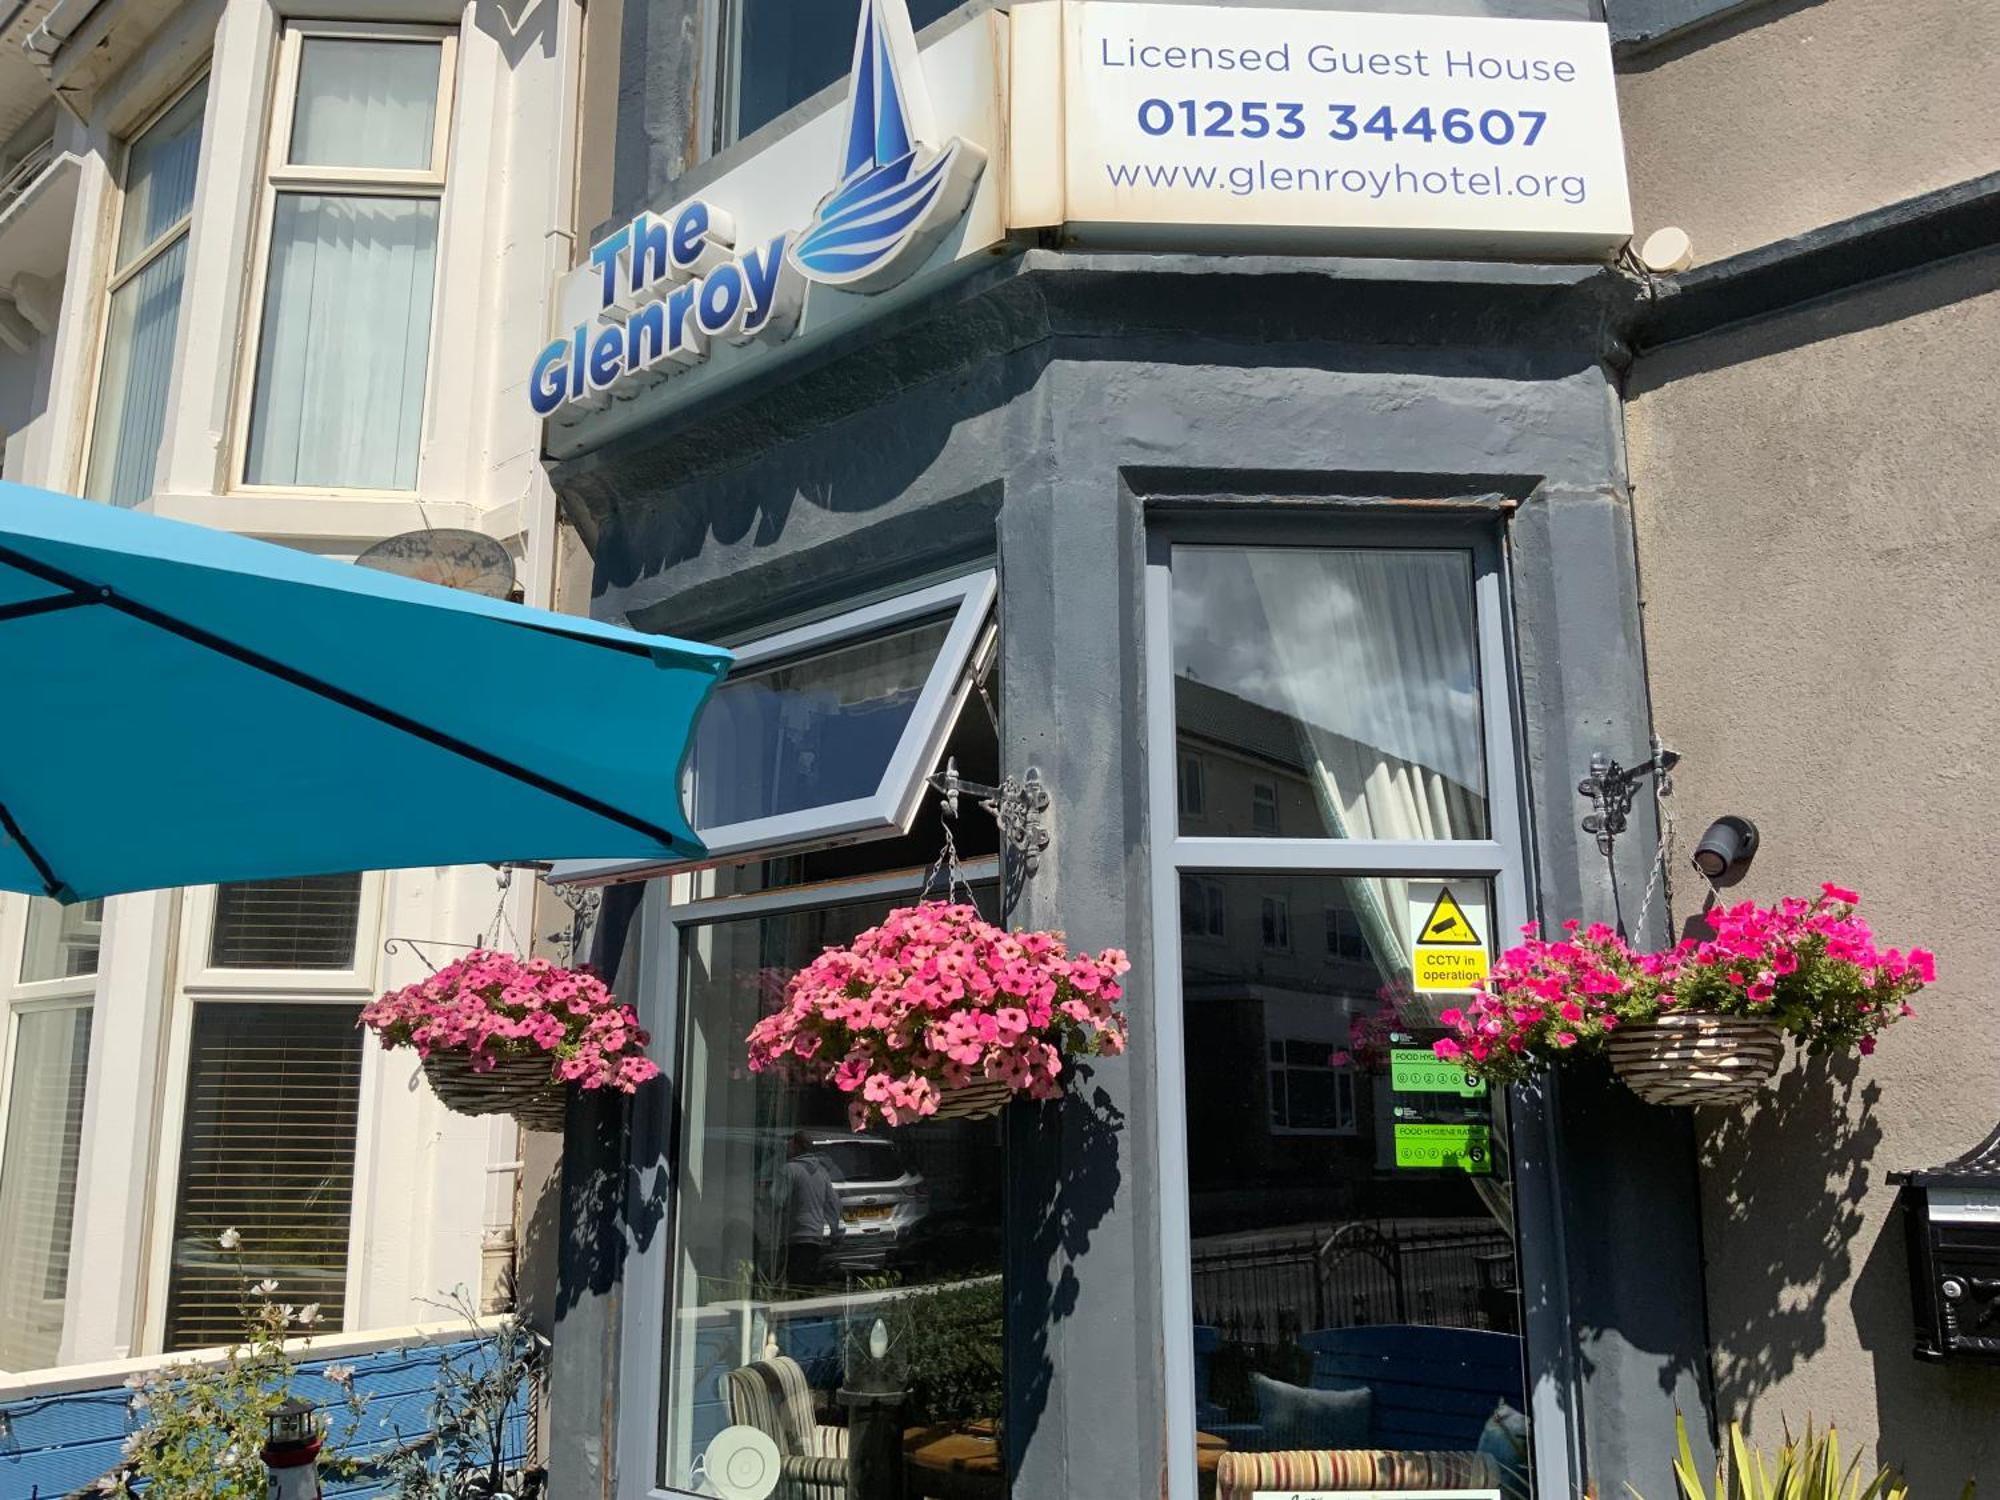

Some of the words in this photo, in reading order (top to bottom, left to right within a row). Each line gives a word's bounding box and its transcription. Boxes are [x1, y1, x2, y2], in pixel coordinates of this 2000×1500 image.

[1101, 38, 1291, 73] Licensed
[1307, 45, 1430, 77] Guest
[1446, 50, 1576, 82] House
[1137, 98, 1306, 140] 01253
[1328, 104, 1547, 147] 344607
[1105, 160, 1586, 204] www.glenroyhotel.org
[590, 200, 710, 311] The
[529, 233, 787, 416] Glenroy
[1427, 954, 1461, 966] CCTV
[1464, 955, 1475, 966] in
[1423, 970, 1480, 982] operation
[1395, 1053, 1419, 1061] FOOD
[1467, 1074, 1477, 1086] 5
[1400, 1128, 1422, 1136] FOOD
[1472, 1148, 1482, 1161] 5
